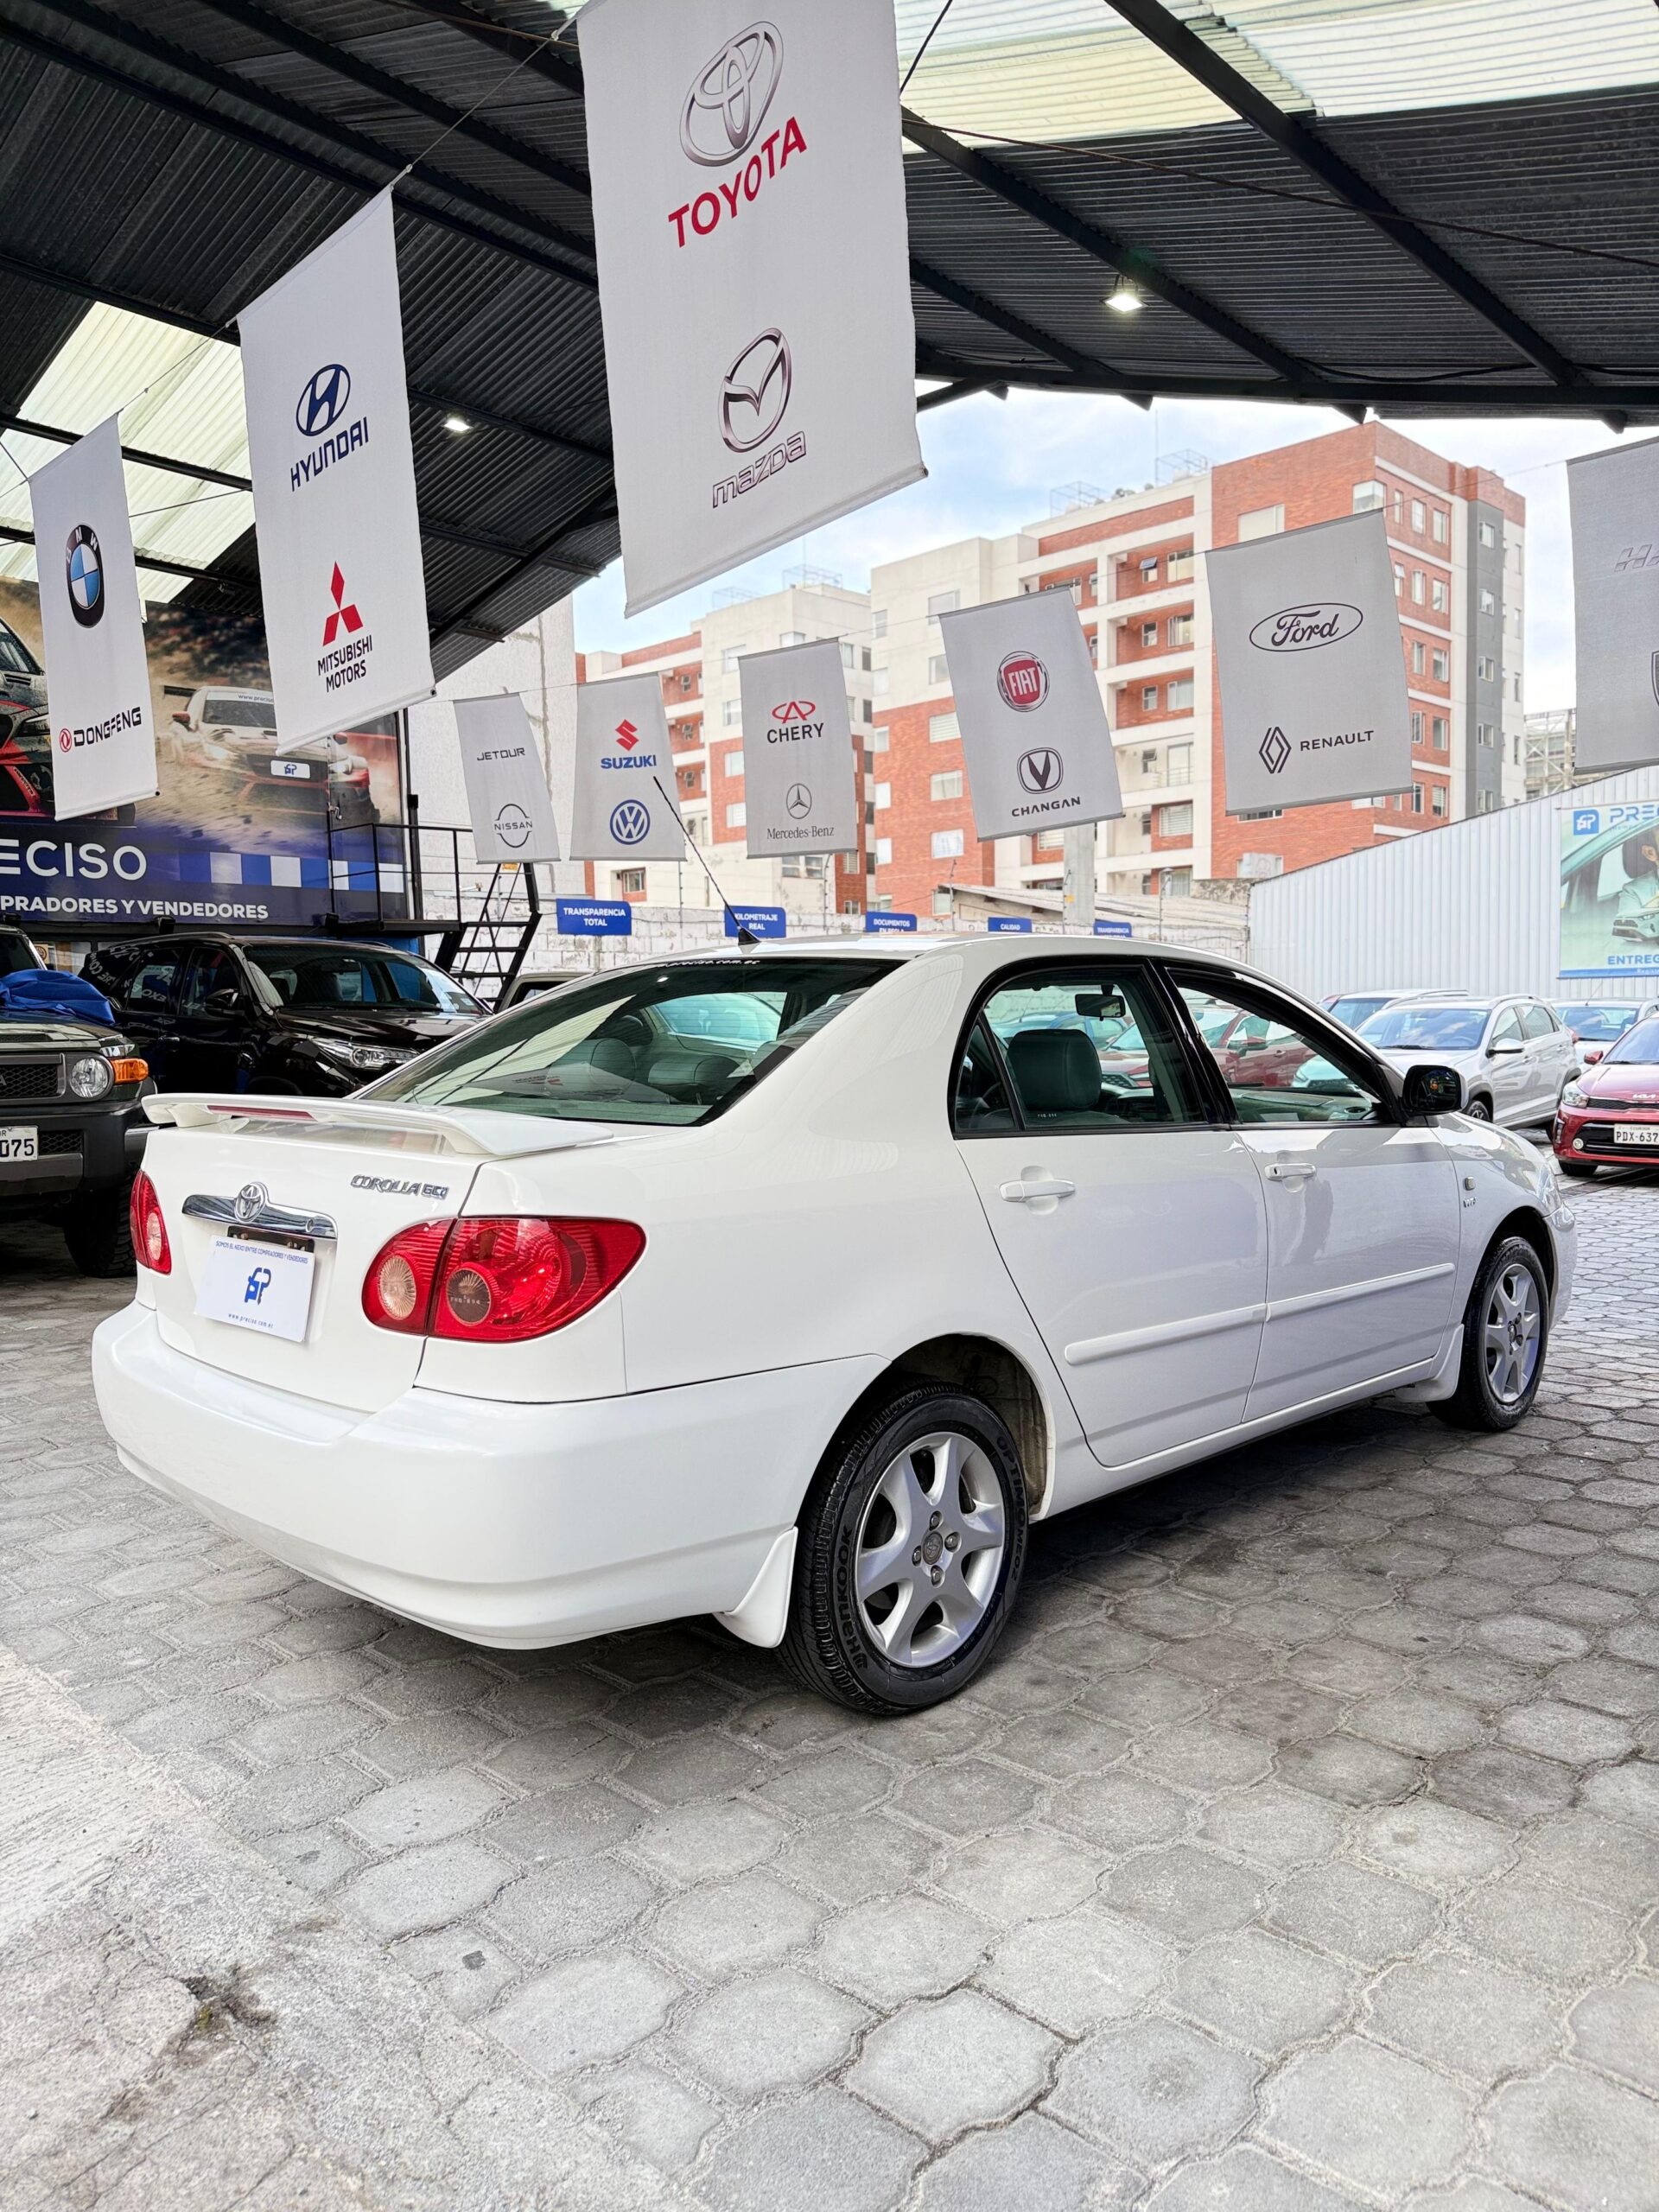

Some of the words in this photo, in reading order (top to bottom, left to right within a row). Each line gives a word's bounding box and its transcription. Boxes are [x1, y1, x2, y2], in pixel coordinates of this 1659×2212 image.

[668, 116, 807, 248] TOYOTA
[289, 416, 368, 492] HYUNDAI
[1271, 609, 1339, 648] Ford
[317, 634, 372, 677] MITSUBISHI
[326, 658, 366, 693] MOTORS
[1007, 666, 1039, 697] FIAT
[73, 707, 142, 747] DONGFENG
[766, 722, 824, 744] CHERY
[1300, 729, 1374, 751] RENAULT
[477, 747, 525, 761] JETOUR
[601, 754, 657, 769] SUZUKI
[1011, 796, 1081, 817] CHANGAN
[493, 820, 533, 831] NISSAN
[766, 825, 835, 840] Mercedes-Benz
[0, 895, 118, 913] PRADORES
[120, 899, 138, 914] Y
[137, 900, 269, 919] VENDEDORES
[563, 907, 626, 917] TRANSPARENCIA
[734, 913, 778, 922] KILOMETRAJE
[584, 918, 607, 926] TOTAL
[748, 922, 766, 931] REAL
[873, 918, 911, 927] DOCUMENTOS
[1000, 922, 1021, 931] CALIDAD
[1616, 1131, 1659, 1143] PDX-637
[350, 1174, 422, 1196] COROLLA
